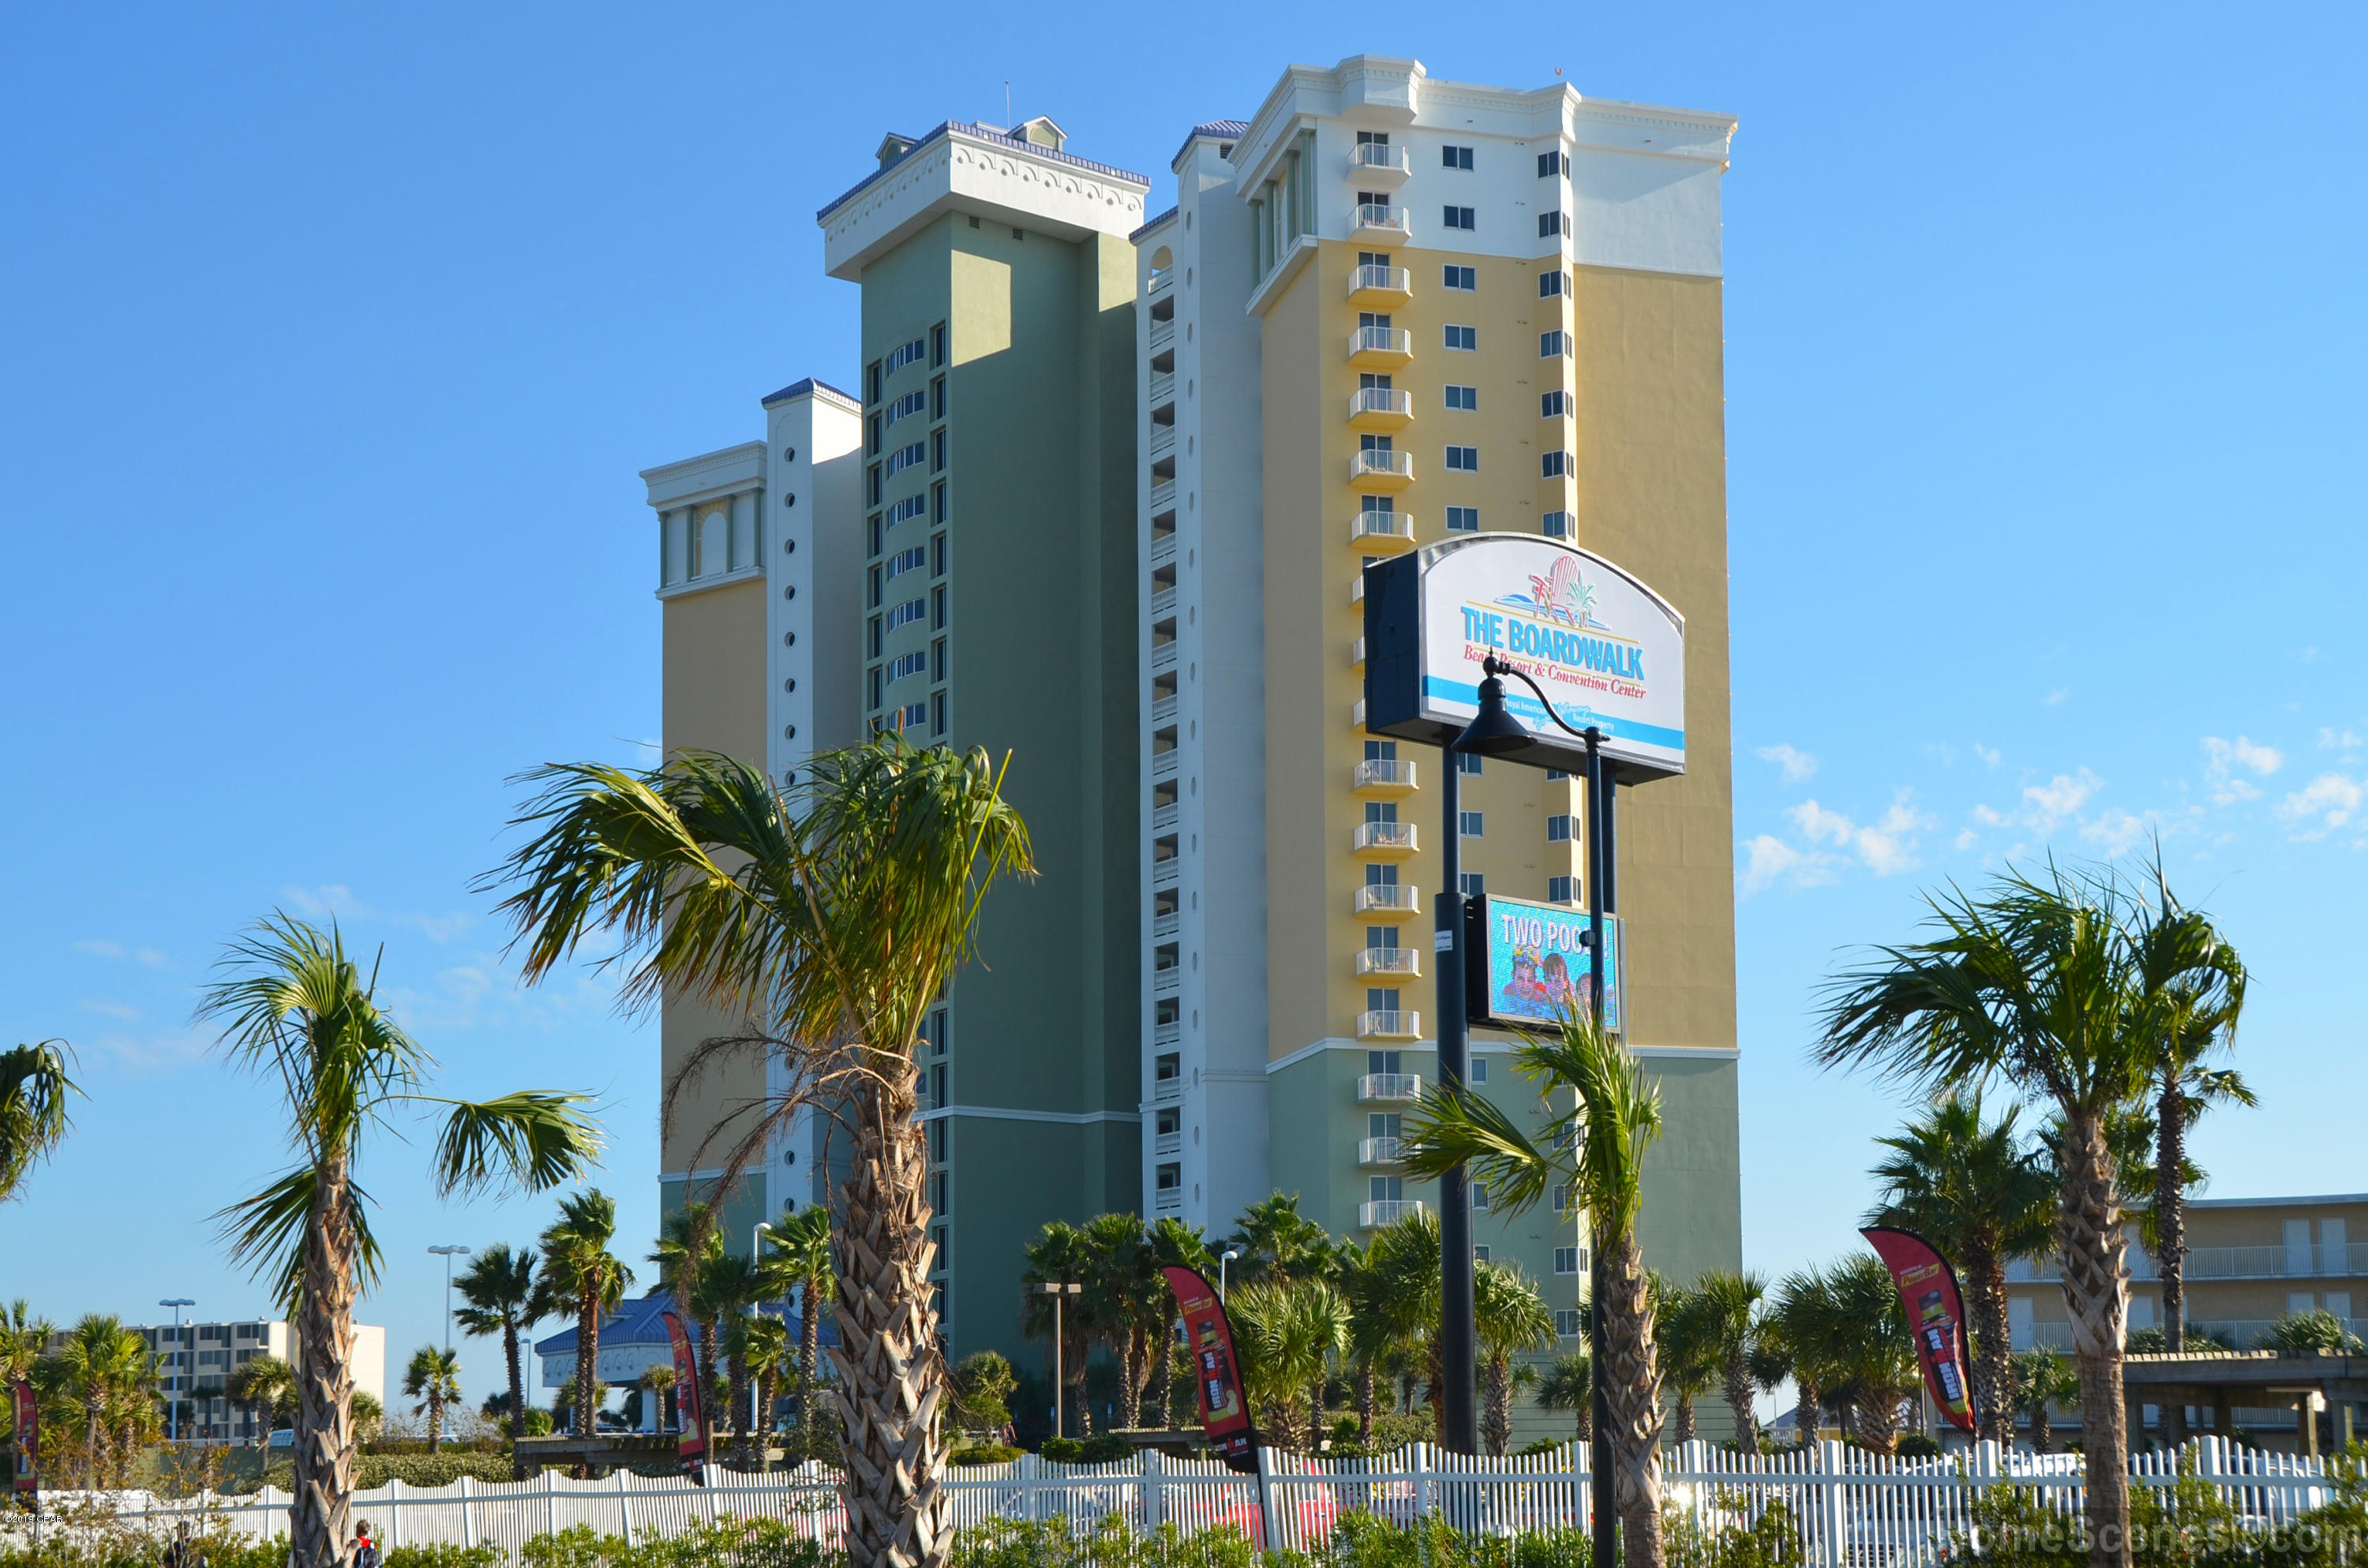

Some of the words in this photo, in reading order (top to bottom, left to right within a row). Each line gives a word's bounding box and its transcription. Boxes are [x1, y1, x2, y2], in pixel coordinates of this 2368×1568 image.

[1461, 606, 1504, 649] THE
[1509, 618, 1645, 680] BOARDWALK
[1463, 644, 1494, 665] Bea
[1534, 663, 1546, 677] &
[1549, 664, 1608, 691] Convention
[1611, 679, 1647, 699] Center
[1502, 915, 1542, 948] TWO
